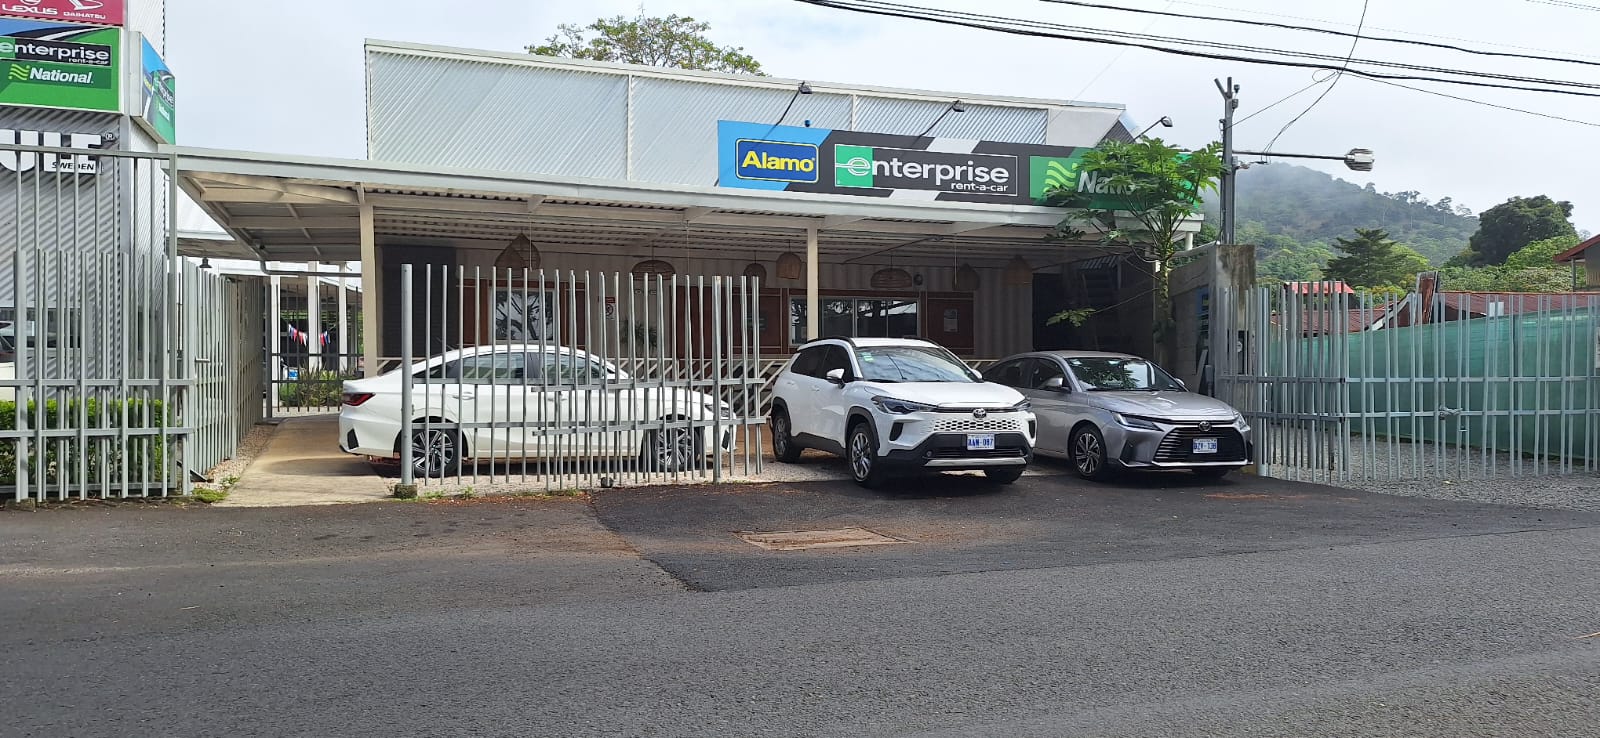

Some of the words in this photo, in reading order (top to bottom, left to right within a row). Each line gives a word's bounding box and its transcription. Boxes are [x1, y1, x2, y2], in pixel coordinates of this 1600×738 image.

[2, 4, 58, 15] LEXUS
[63, 11, 106, 20] DAIHATSU
[0, 41, 109, 60] enterprise
[69, 57, 109, 65] rent-a-car
[741, 150, 814, 173] Alamo
[847, 157, 1009, 186] enterprise
[950, 181, 1009, 193] rent-a-car
